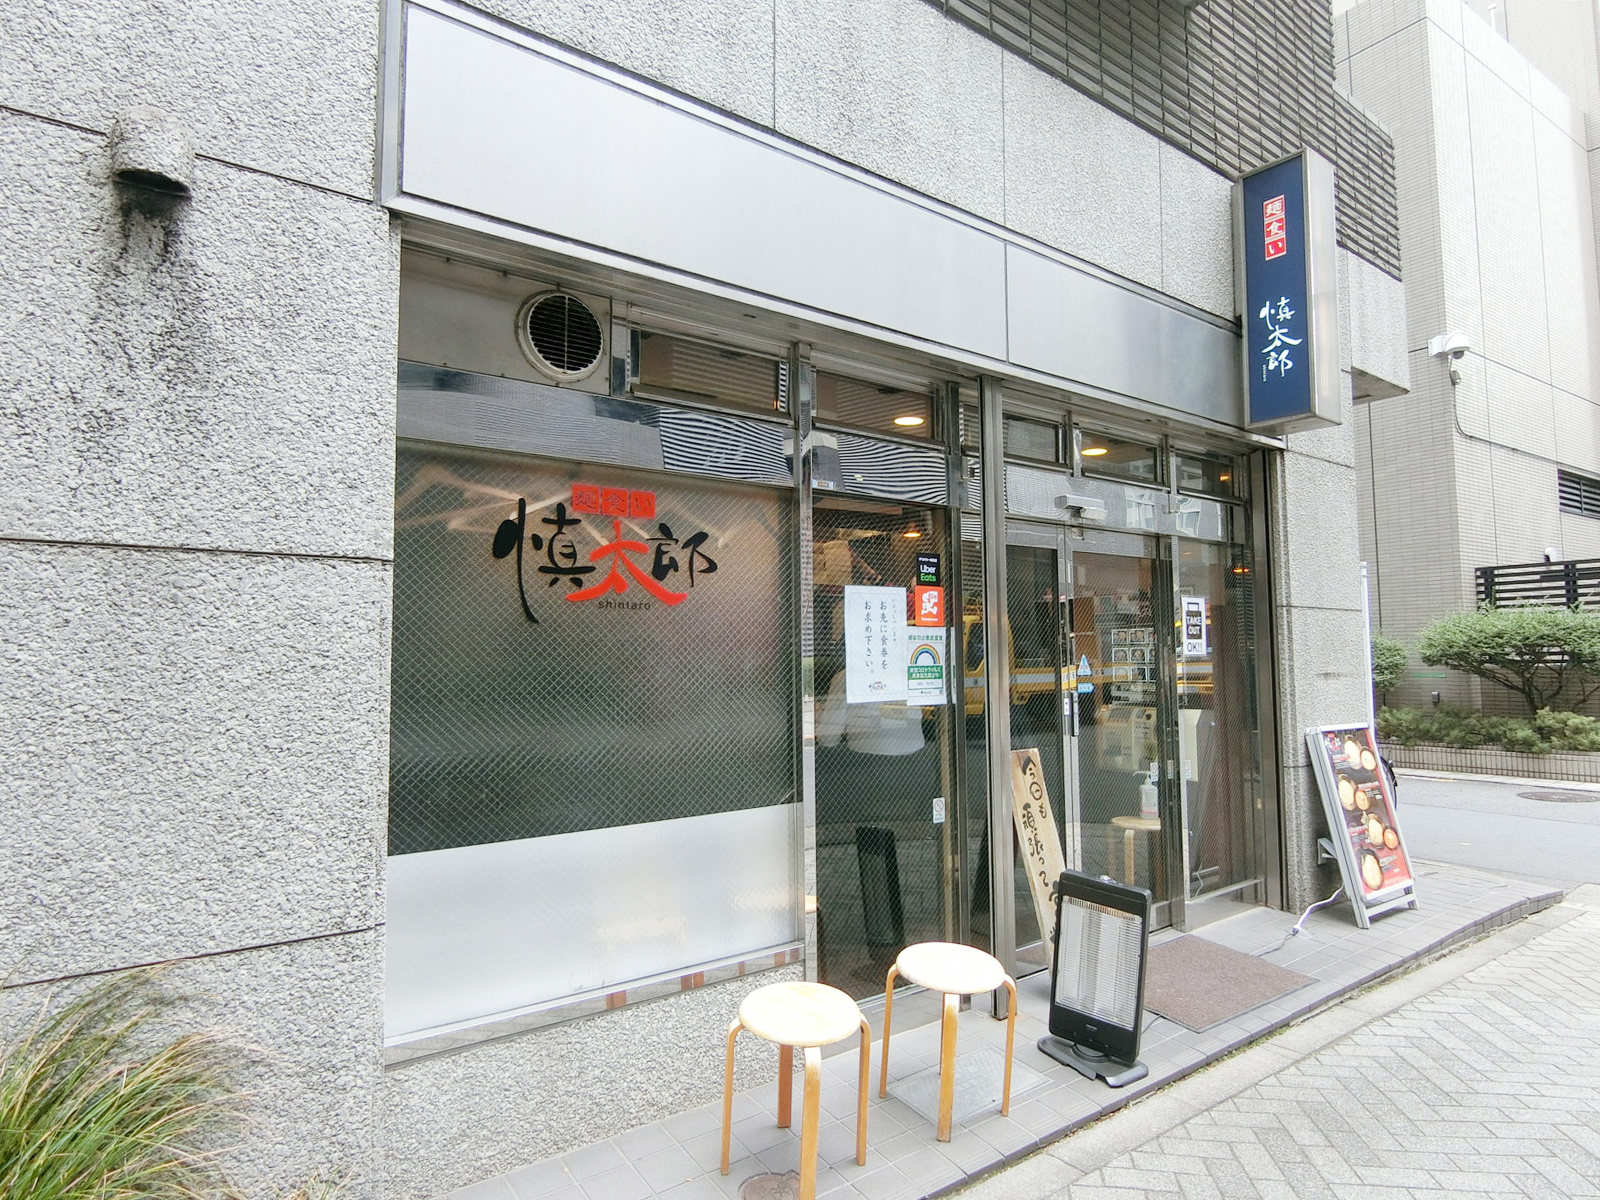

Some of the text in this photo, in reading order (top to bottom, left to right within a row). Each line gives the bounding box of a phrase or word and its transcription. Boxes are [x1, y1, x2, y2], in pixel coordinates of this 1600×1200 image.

[1264, 197, 1286, 259] 麺食い
[1259, 296, 1302, 378] 慎太郎
[492, 498, 718, 624] 慎太郎
[920, 565, 936, 574] Uber
[920, 573, 936, 583] Eats
[598, 600, 651, 611] shintaro
[1186, 616, 1202, 625] TAKE
[864, 600, 875, 674] お求め下さい。
[879, 600, 888, 670] お先に食券を
[1188, 626, 1200, 635] OUT
